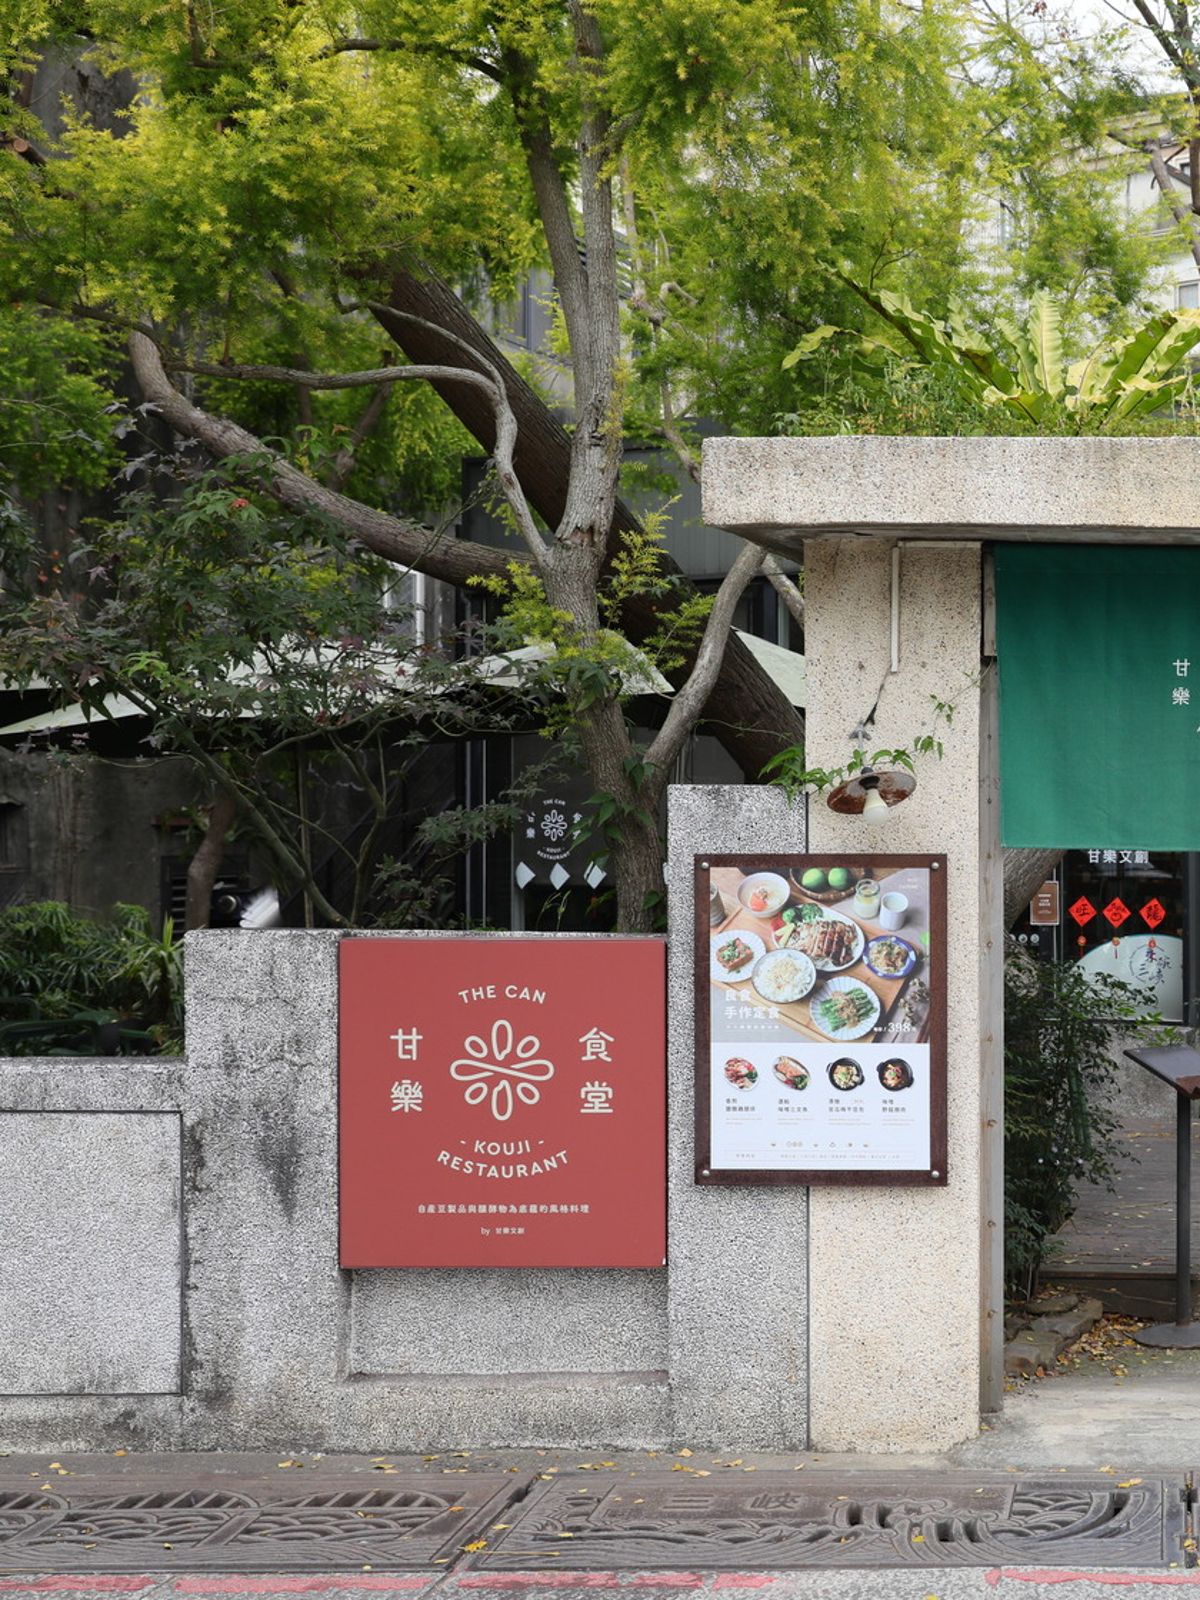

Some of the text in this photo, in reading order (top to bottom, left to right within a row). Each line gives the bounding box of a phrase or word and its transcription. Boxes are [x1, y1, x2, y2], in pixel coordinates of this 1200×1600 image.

[1172, 658, 1191, 706] 甘樂
[1087, 849, 1149, 864] 甘樂文創
[458, 984, 547, 1004] THE CAN
[724, 1006, 780, 1019] 手作定食
[888, 1022, 911, 1033] 398
[389, 1026, 615, 1114] 甘樂 食堂
[473, 1139, 531, 1156] KOUJI
[436, 1150, 570, 1179] RESTAURANT
[480, 1227, 491, 1237] by
[662, 1492, 802, 1511] 三峽
